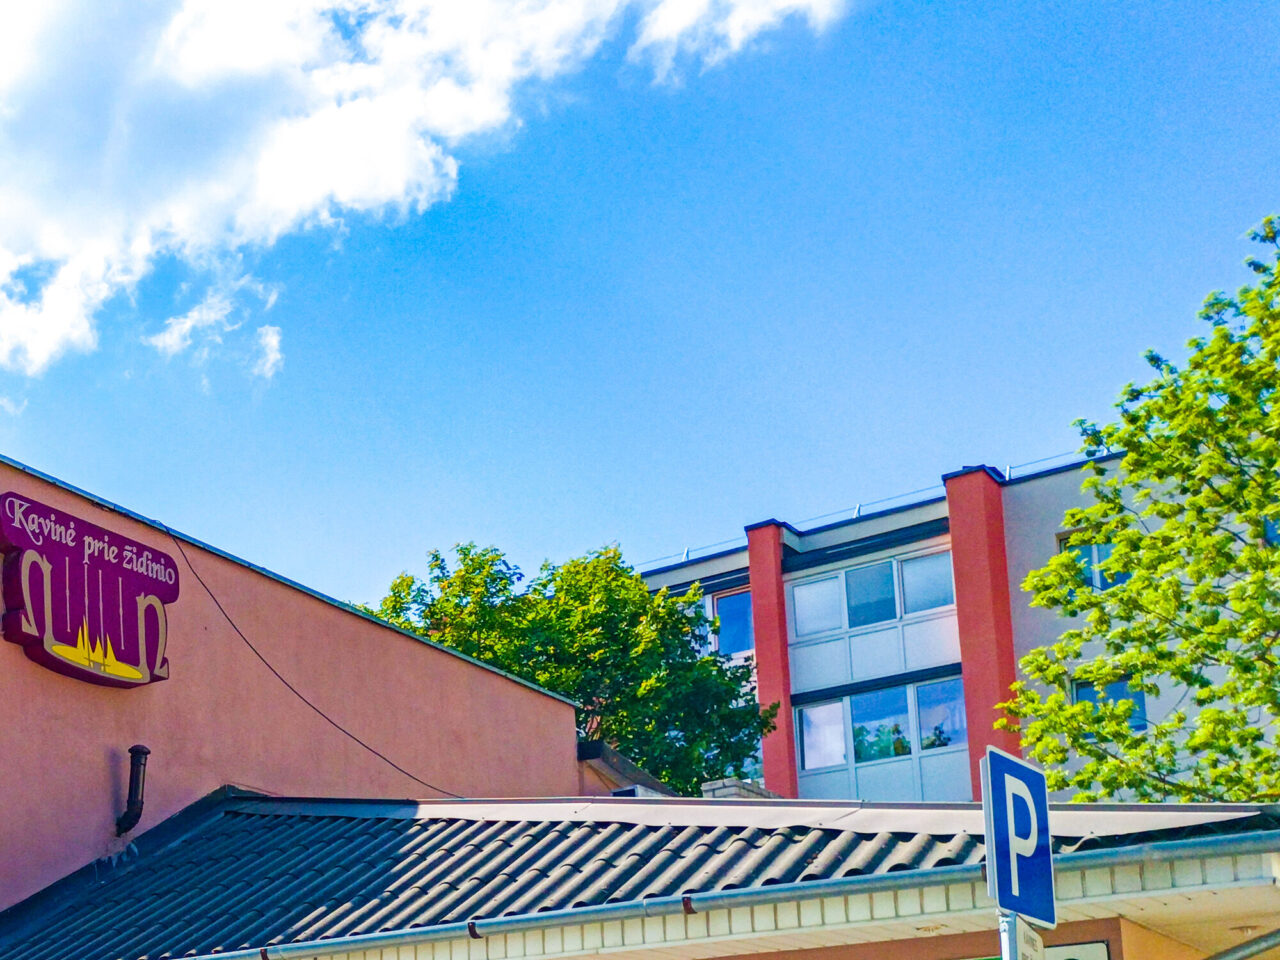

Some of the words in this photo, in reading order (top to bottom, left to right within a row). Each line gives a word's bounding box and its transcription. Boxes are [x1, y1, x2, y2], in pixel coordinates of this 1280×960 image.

[5, 497, 76, 546] Kavinė
[83, 535, 118, 564] prie
[122, 545, 176, 585] židinio
[1004, 773, 1038, 897] P
